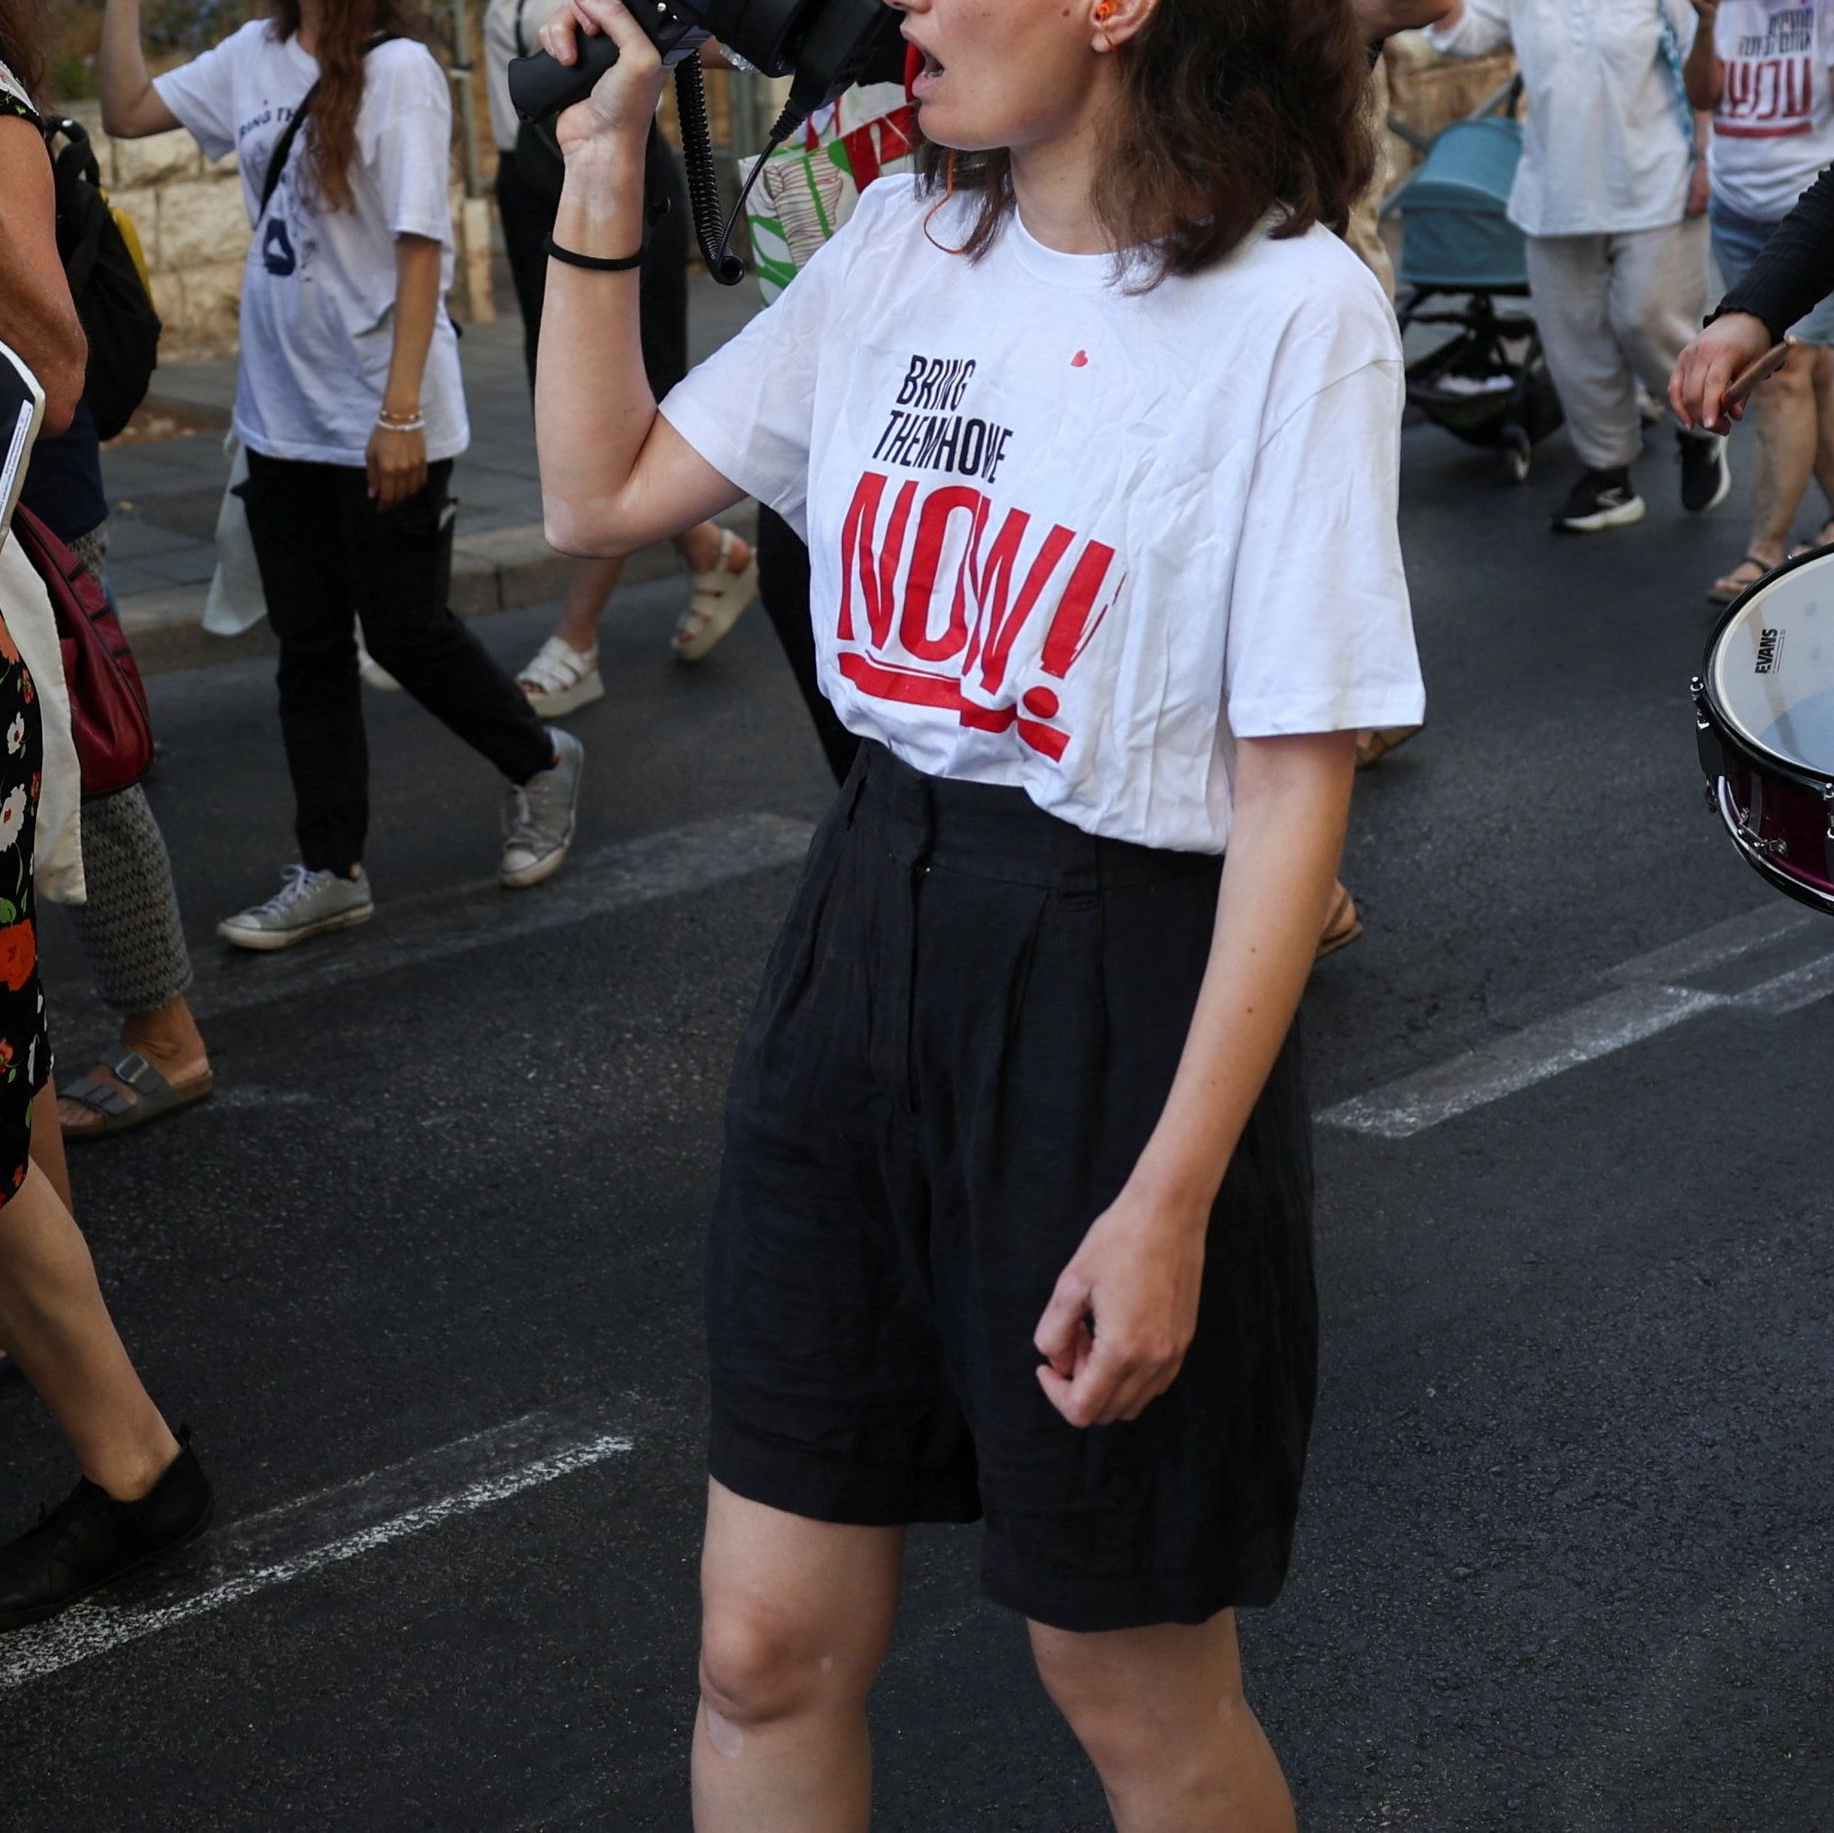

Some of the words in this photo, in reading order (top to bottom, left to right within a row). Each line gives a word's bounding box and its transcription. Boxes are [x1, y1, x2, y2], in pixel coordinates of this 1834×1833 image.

[896, 354, 976, 412] BRING
[872, 409, 951, 470] THEM
[932, 415, 1014, 485] HOME
[837, 470, 1127, 719] NOW!
[1754, 627, 1779, 674] EVANS
